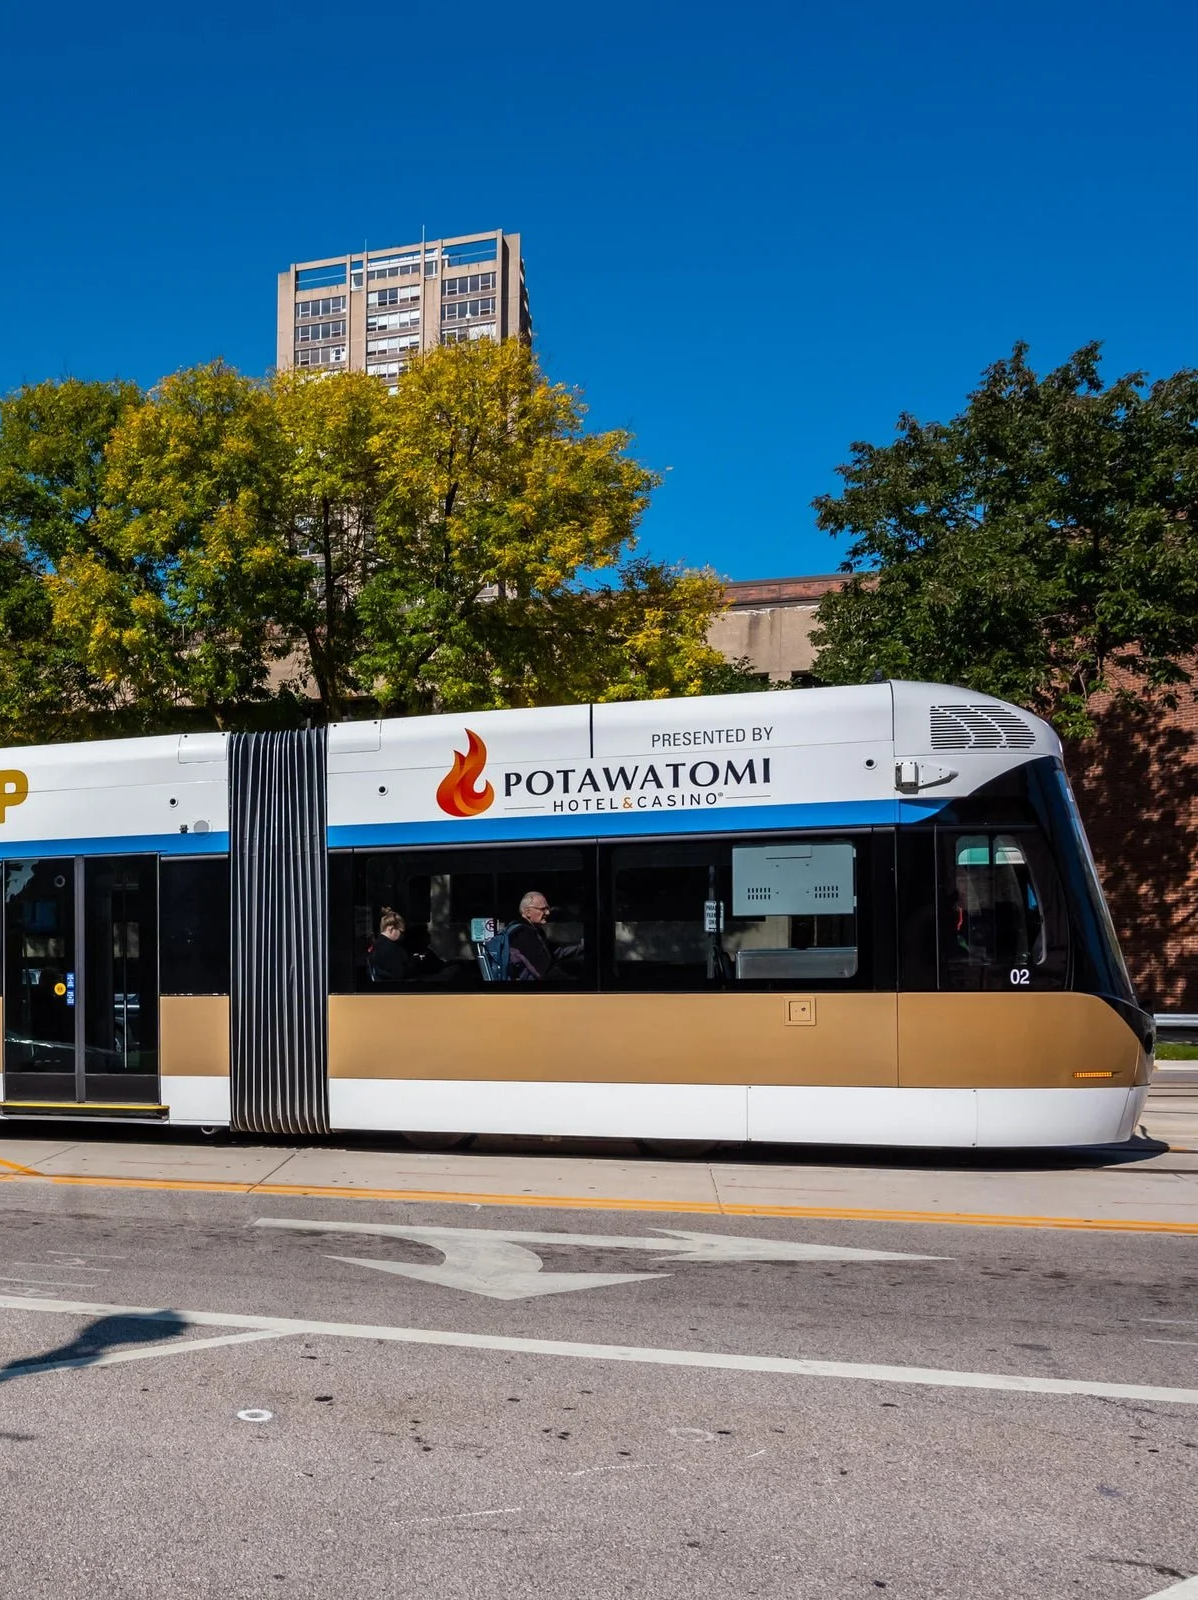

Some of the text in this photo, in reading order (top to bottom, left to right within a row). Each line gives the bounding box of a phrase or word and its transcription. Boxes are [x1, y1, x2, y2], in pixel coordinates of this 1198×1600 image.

[651, 726, 774, 748] PRESENTED BY
[504, 758, 771, 797] POTAWATOMI
[1010, 968, 1030, 985] 02
